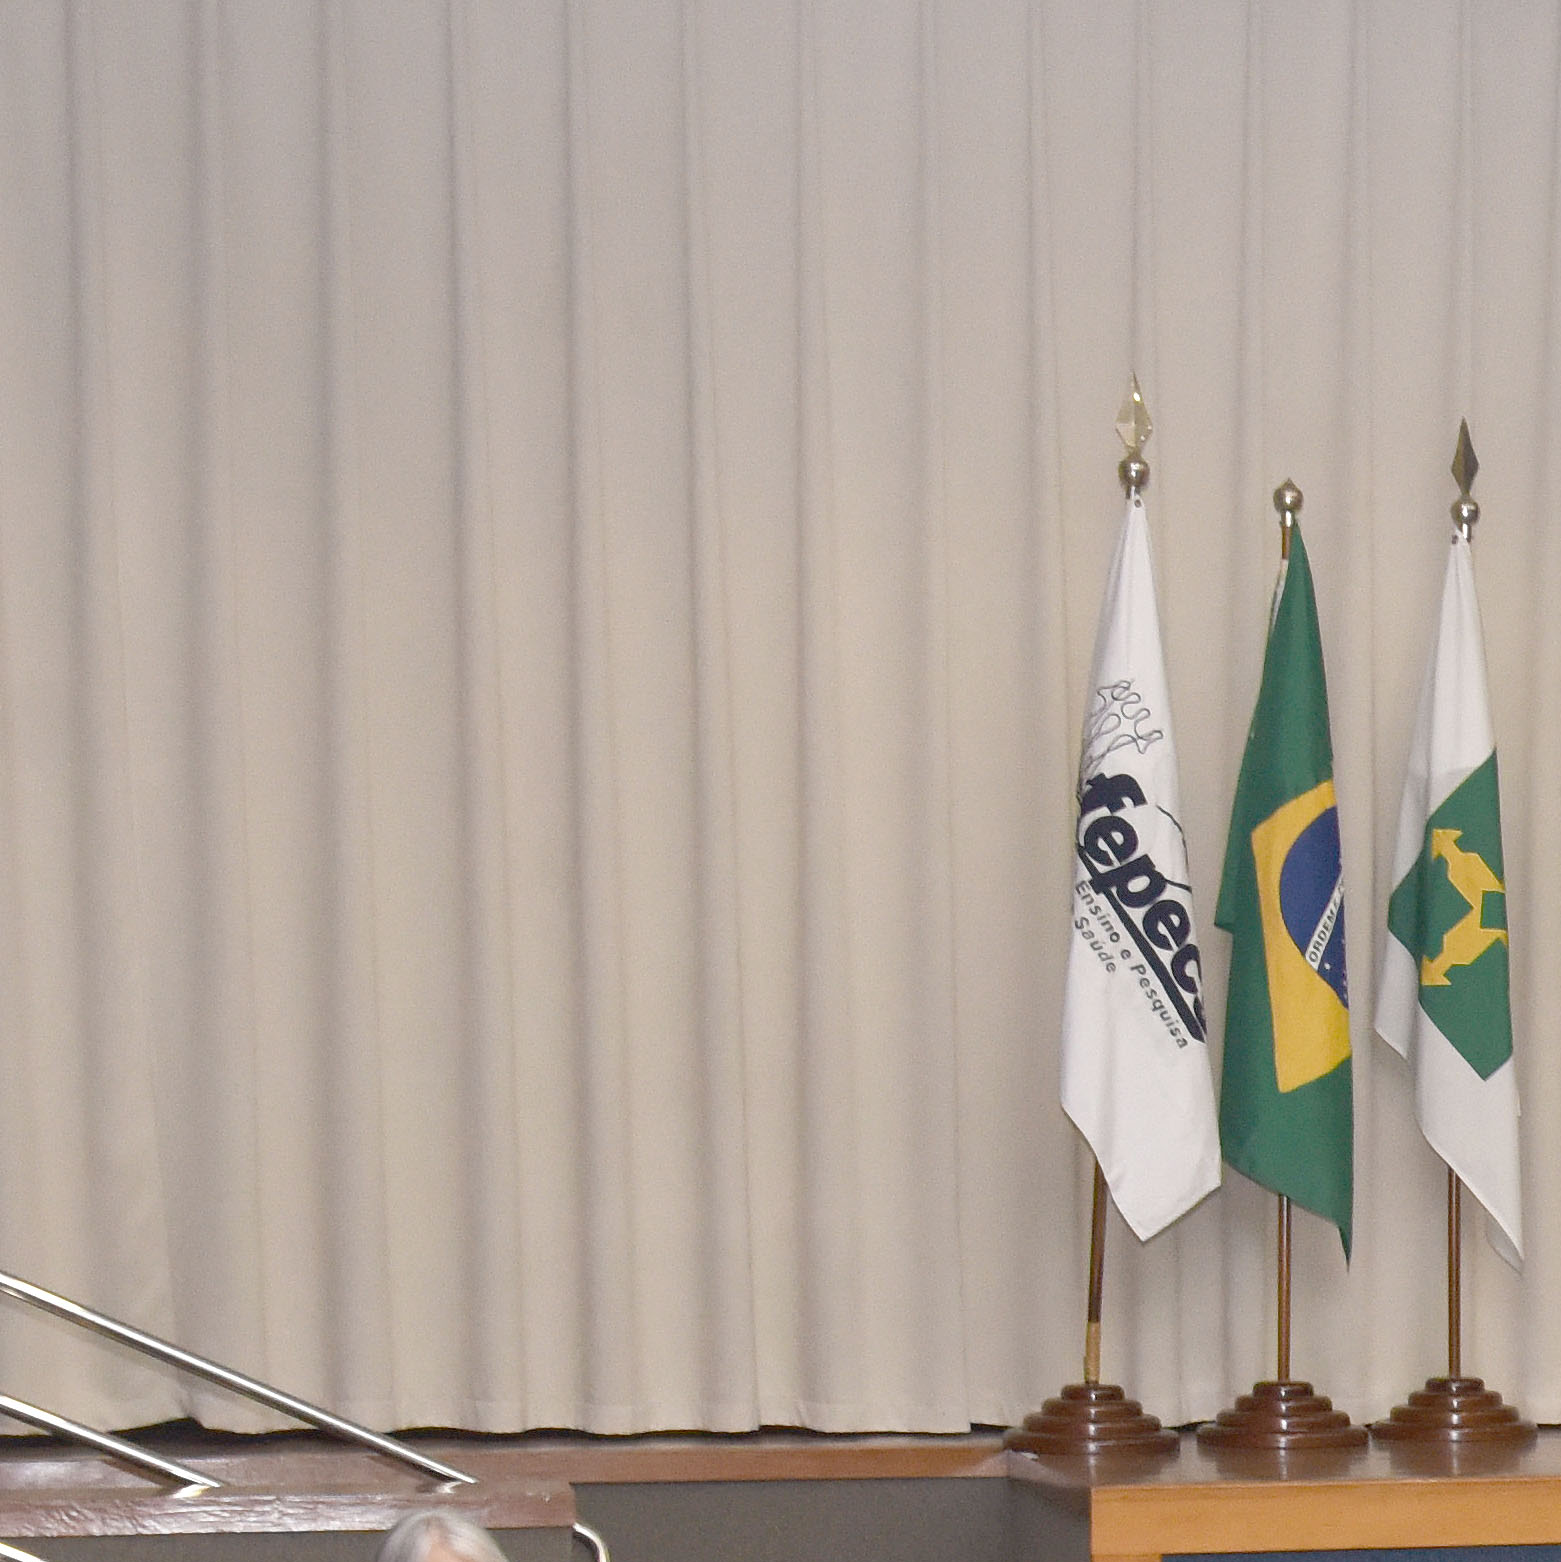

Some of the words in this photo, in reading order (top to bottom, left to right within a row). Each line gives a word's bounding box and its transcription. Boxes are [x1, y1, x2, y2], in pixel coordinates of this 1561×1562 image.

[1075, 917, 1117, 973] Saúde
[1075, 880, 1121, 943] Ensino
[1121, 949, 1131, 960] e
[1130, 964, 1188, 1048] Pesquisa
